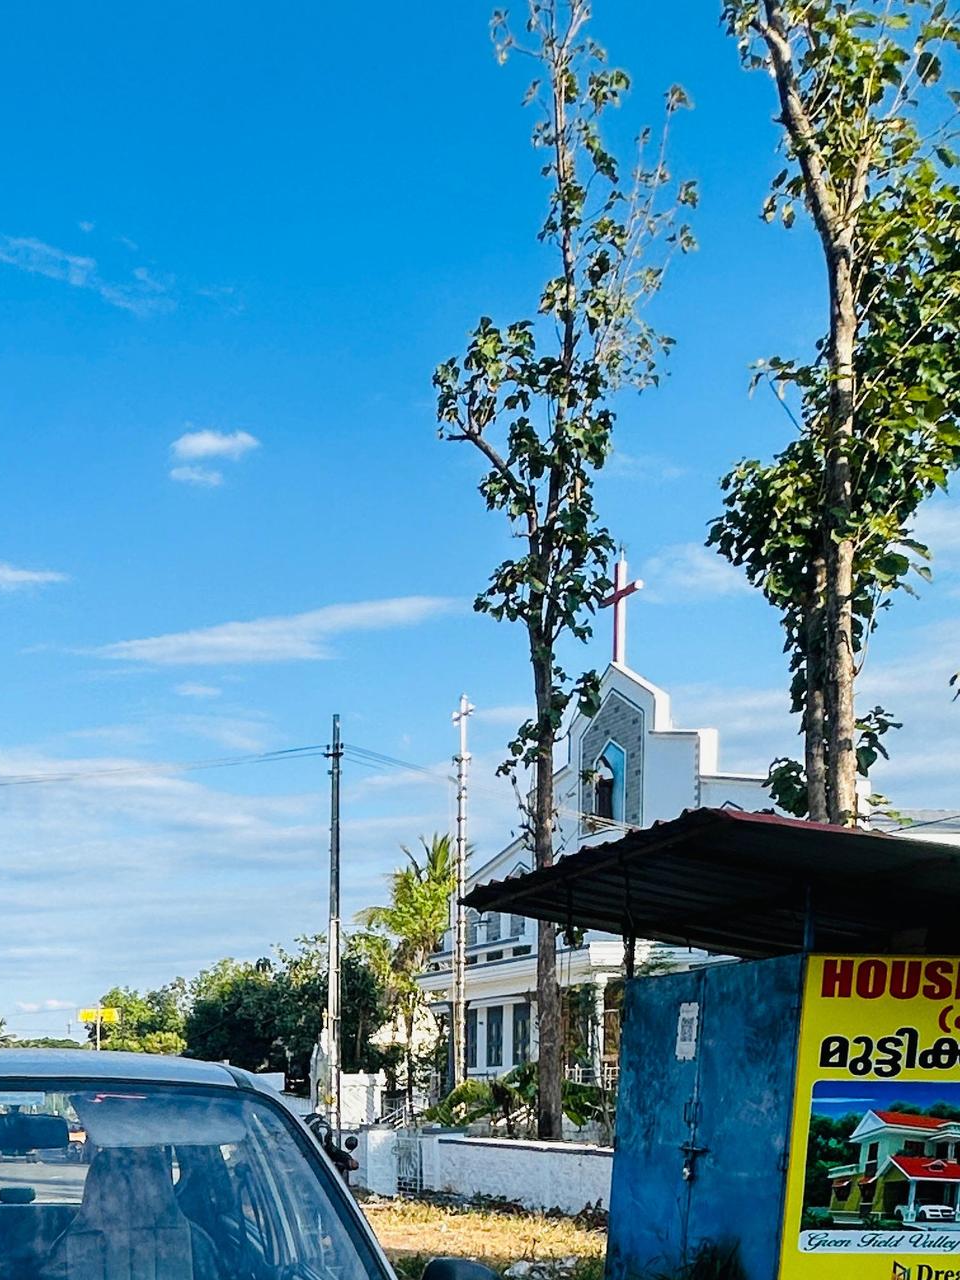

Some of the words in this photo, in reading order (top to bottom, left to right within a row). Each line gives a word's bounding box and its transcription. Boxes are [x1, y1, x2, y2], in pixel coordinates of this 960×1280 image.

[821, 958, 960, 1000] HOUS
[804, 1233, 851, 1251] Green
[857, 1233, 905, 1248] Field
[909, 1233, 960, 1252] Valley
